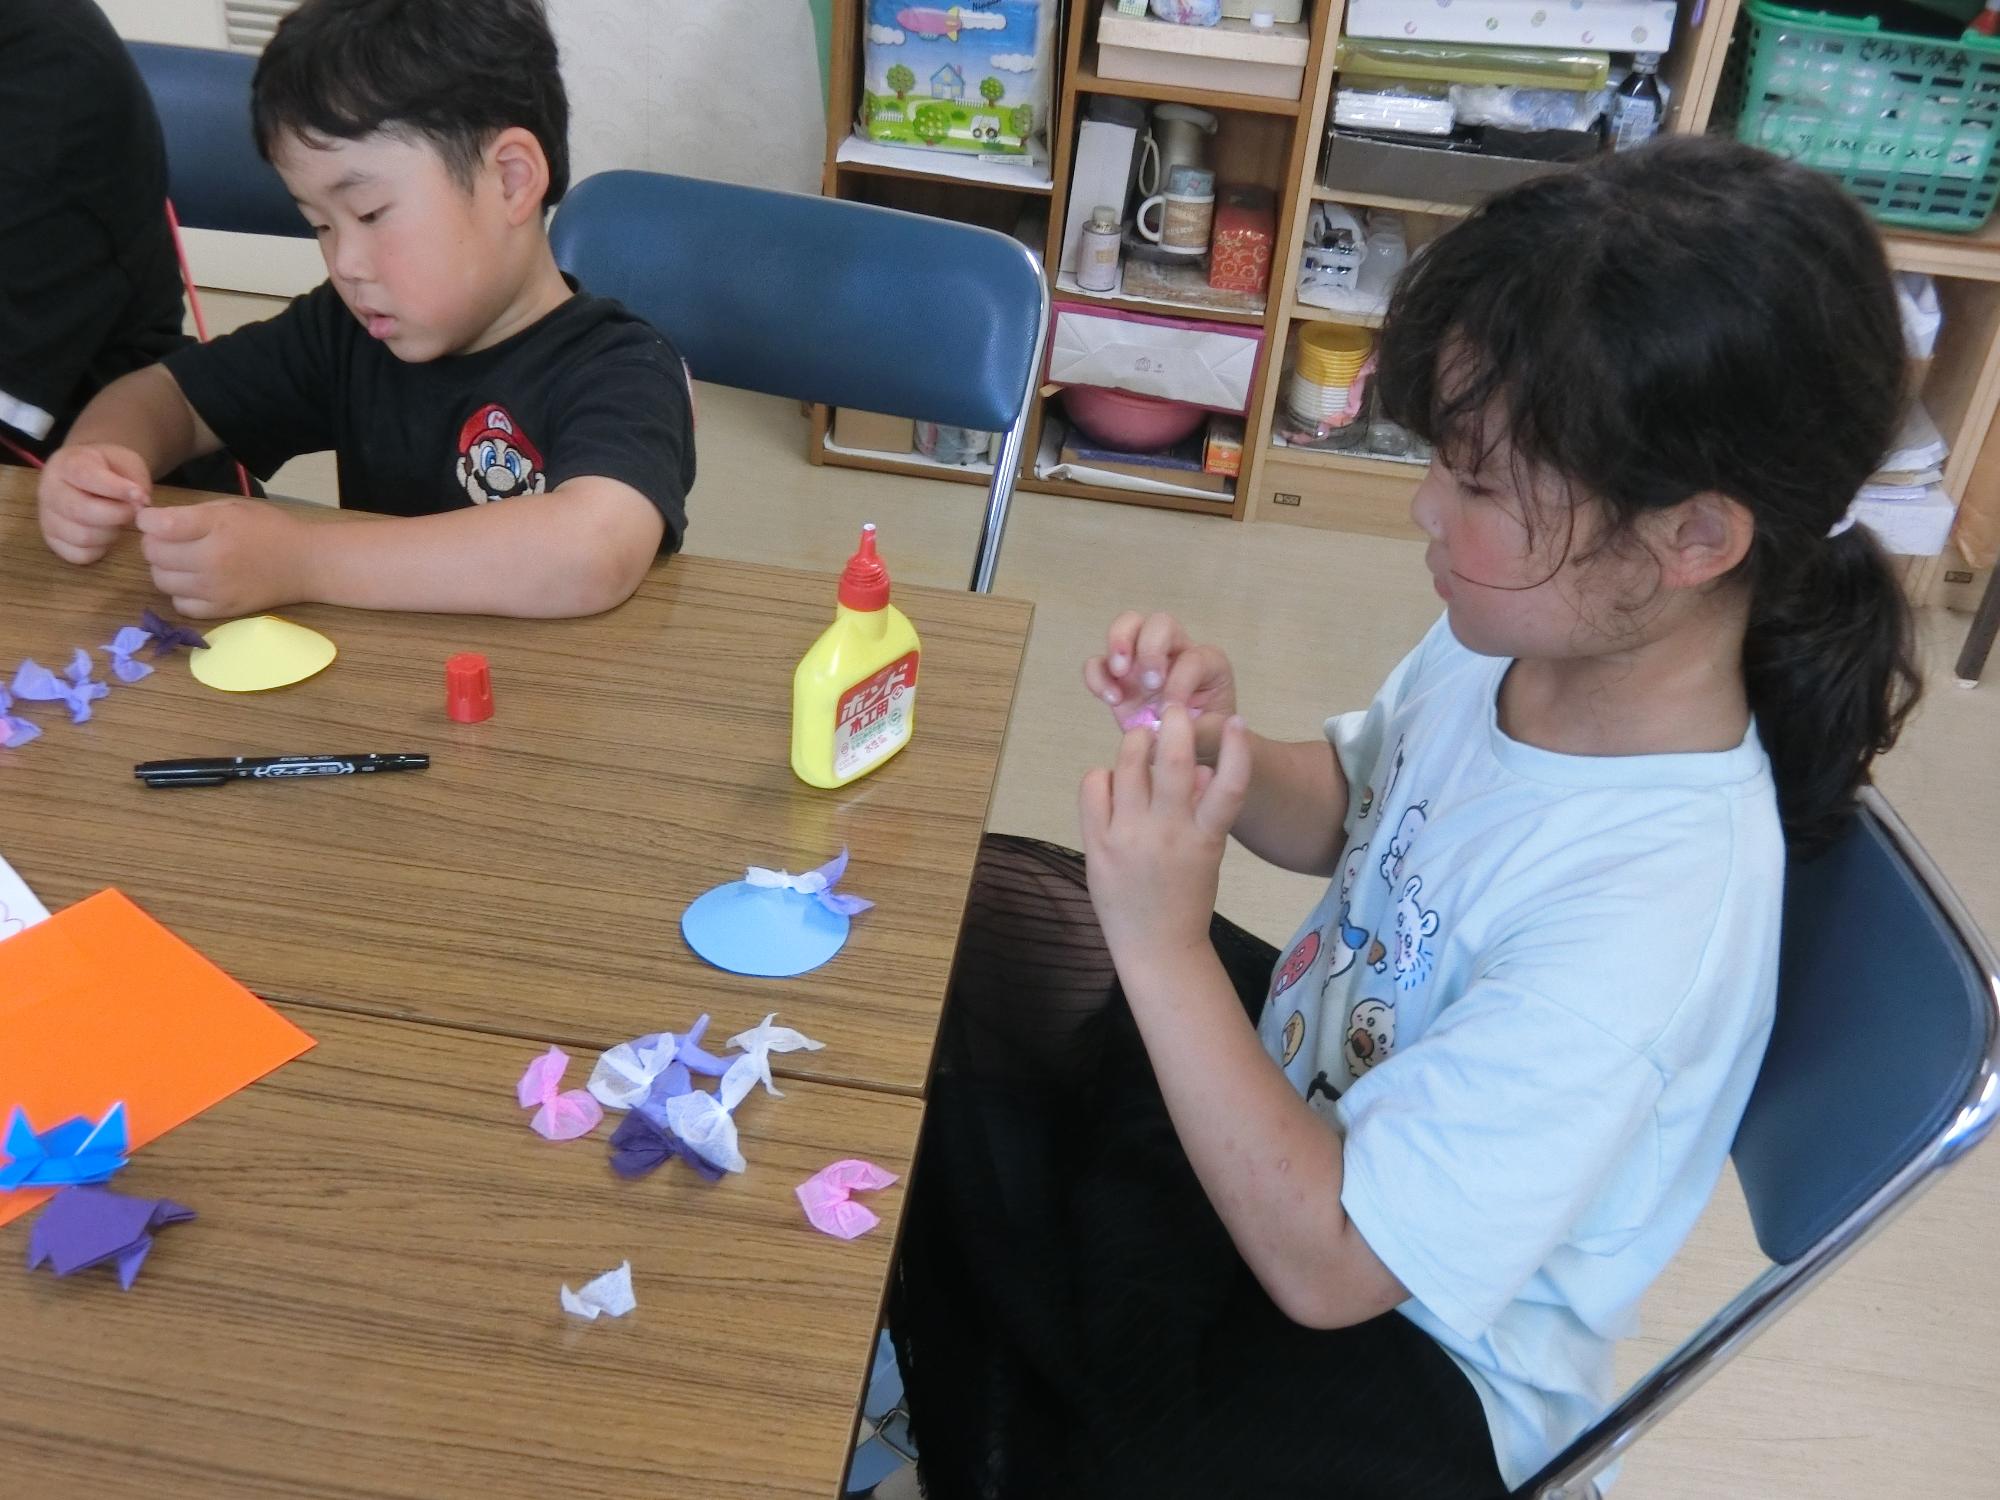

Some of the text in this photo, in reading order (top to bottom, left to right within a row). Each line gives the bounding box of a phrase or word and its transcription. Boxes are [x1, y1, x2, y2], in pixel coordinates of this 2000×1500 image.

[492, 413, 509, 430] M
[840, 663, 908, 723] ボンド
[849, 697, 889, 737] 木工用
